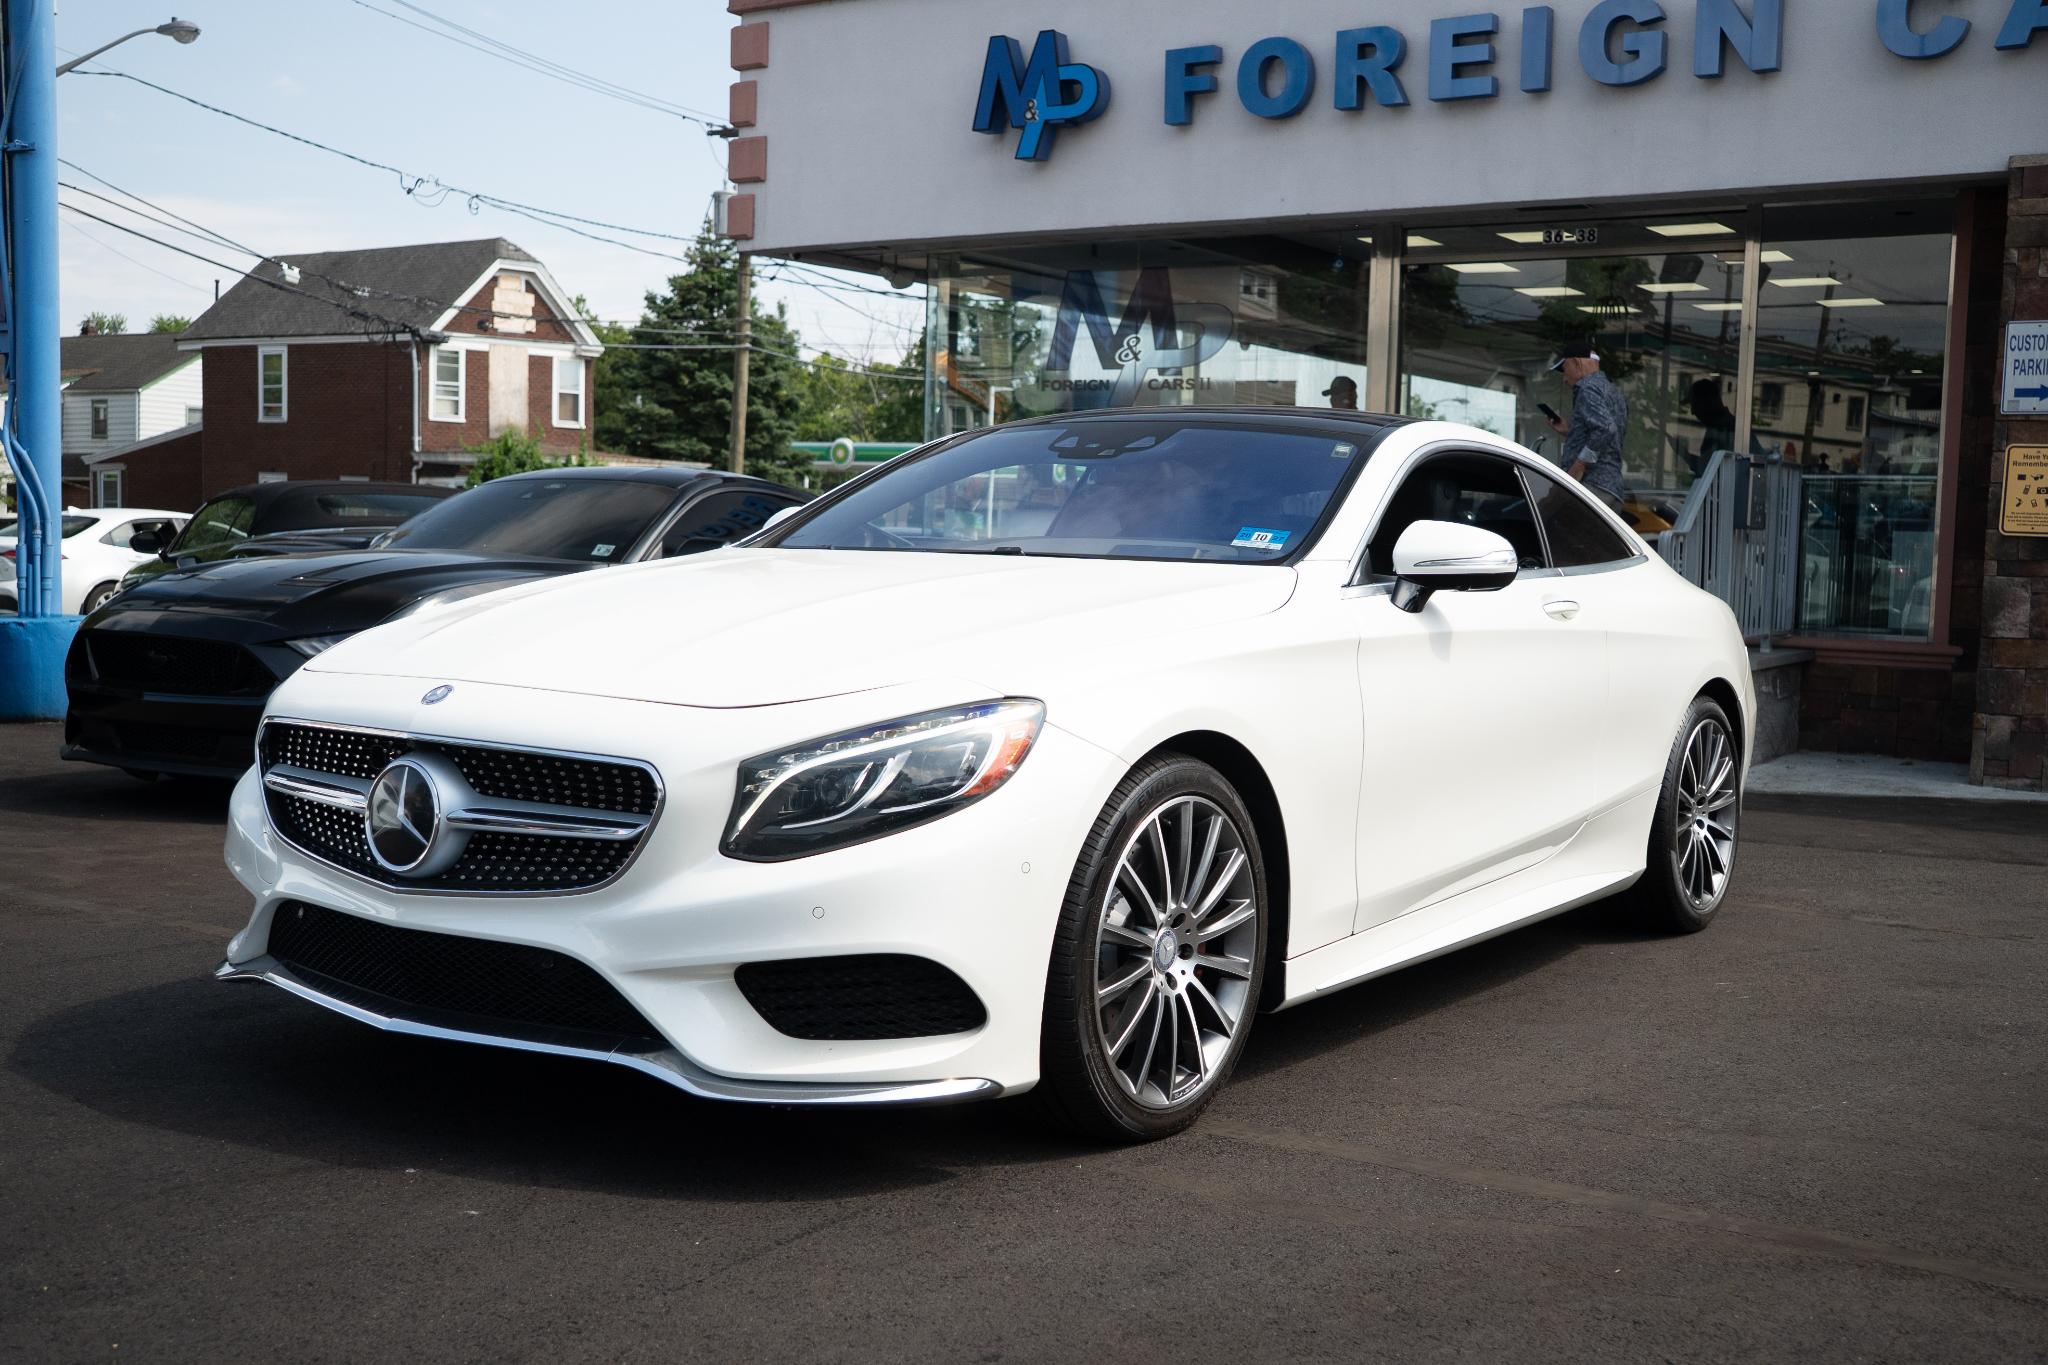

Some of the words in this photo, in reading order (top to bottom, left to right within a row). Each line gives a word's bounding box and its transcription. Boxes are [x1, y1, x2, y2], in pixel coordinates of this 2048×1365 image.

[1164, 0, 1784, 126] FOREIGN
[1543, 229, 1597, 243] 36-38
[1041, 379, 1110, 391] FOREIGN
[1148, 378, 1195, 390] CARS
[1254, 533, 1268, 541] 10
